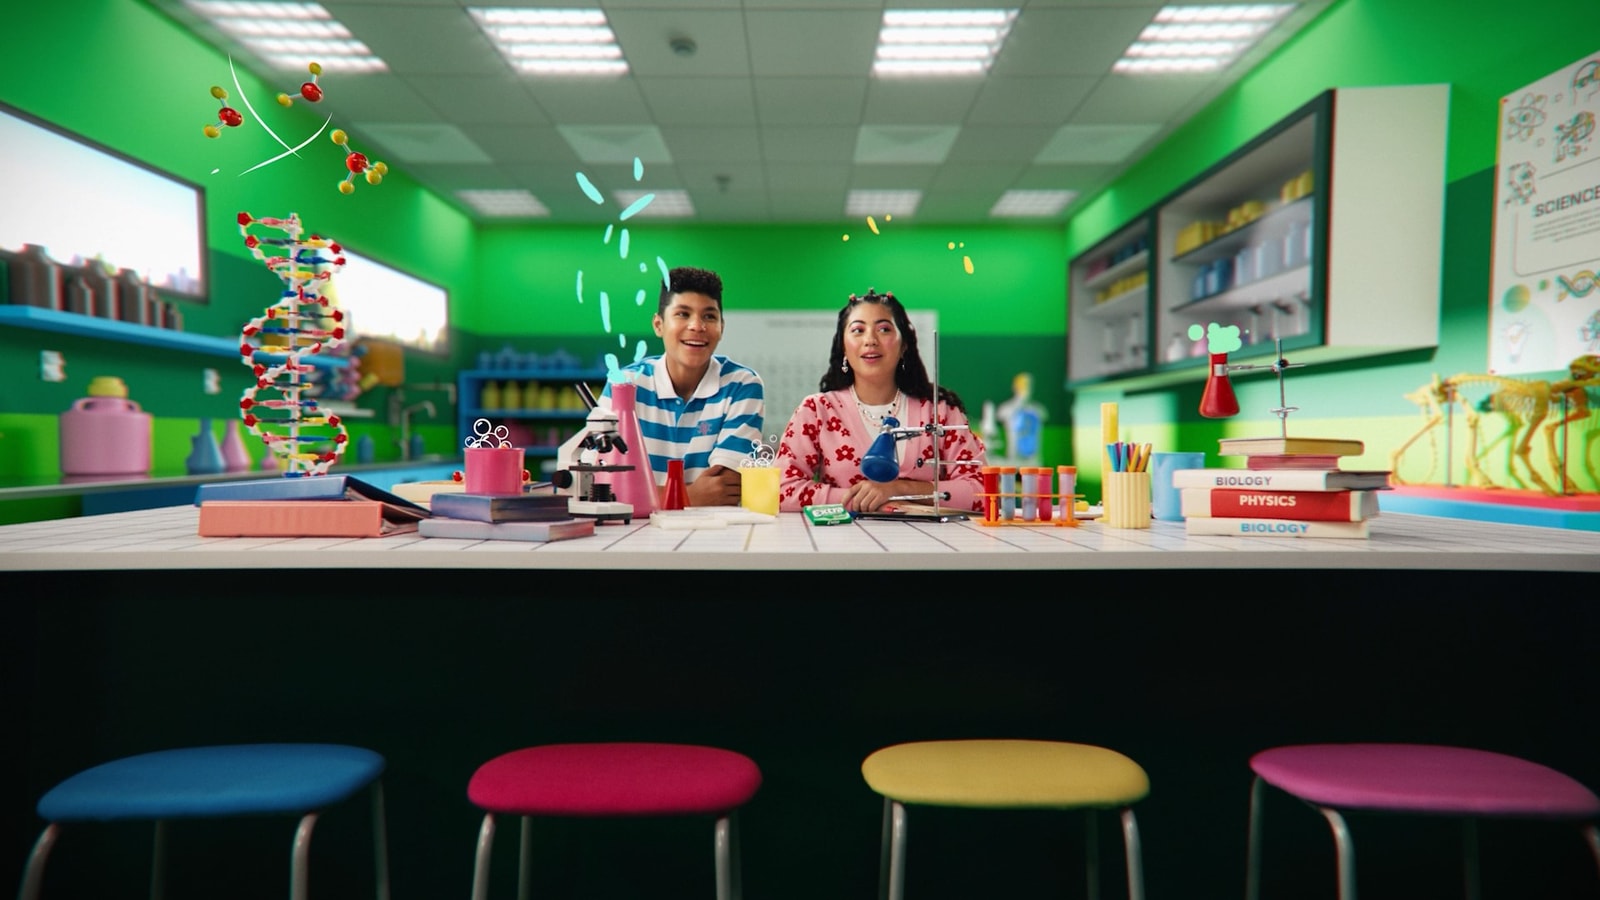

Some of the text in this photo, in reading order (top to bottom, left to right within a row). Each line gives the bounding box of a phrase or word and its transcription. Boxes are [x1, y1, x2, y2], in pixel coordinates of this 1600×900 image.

[1215, 476, 1272, 486] BIOLOGY
[1239, 494, 1297, 507] PHYSICS
[1240, 522, 1309, 534] BIOLOGY
